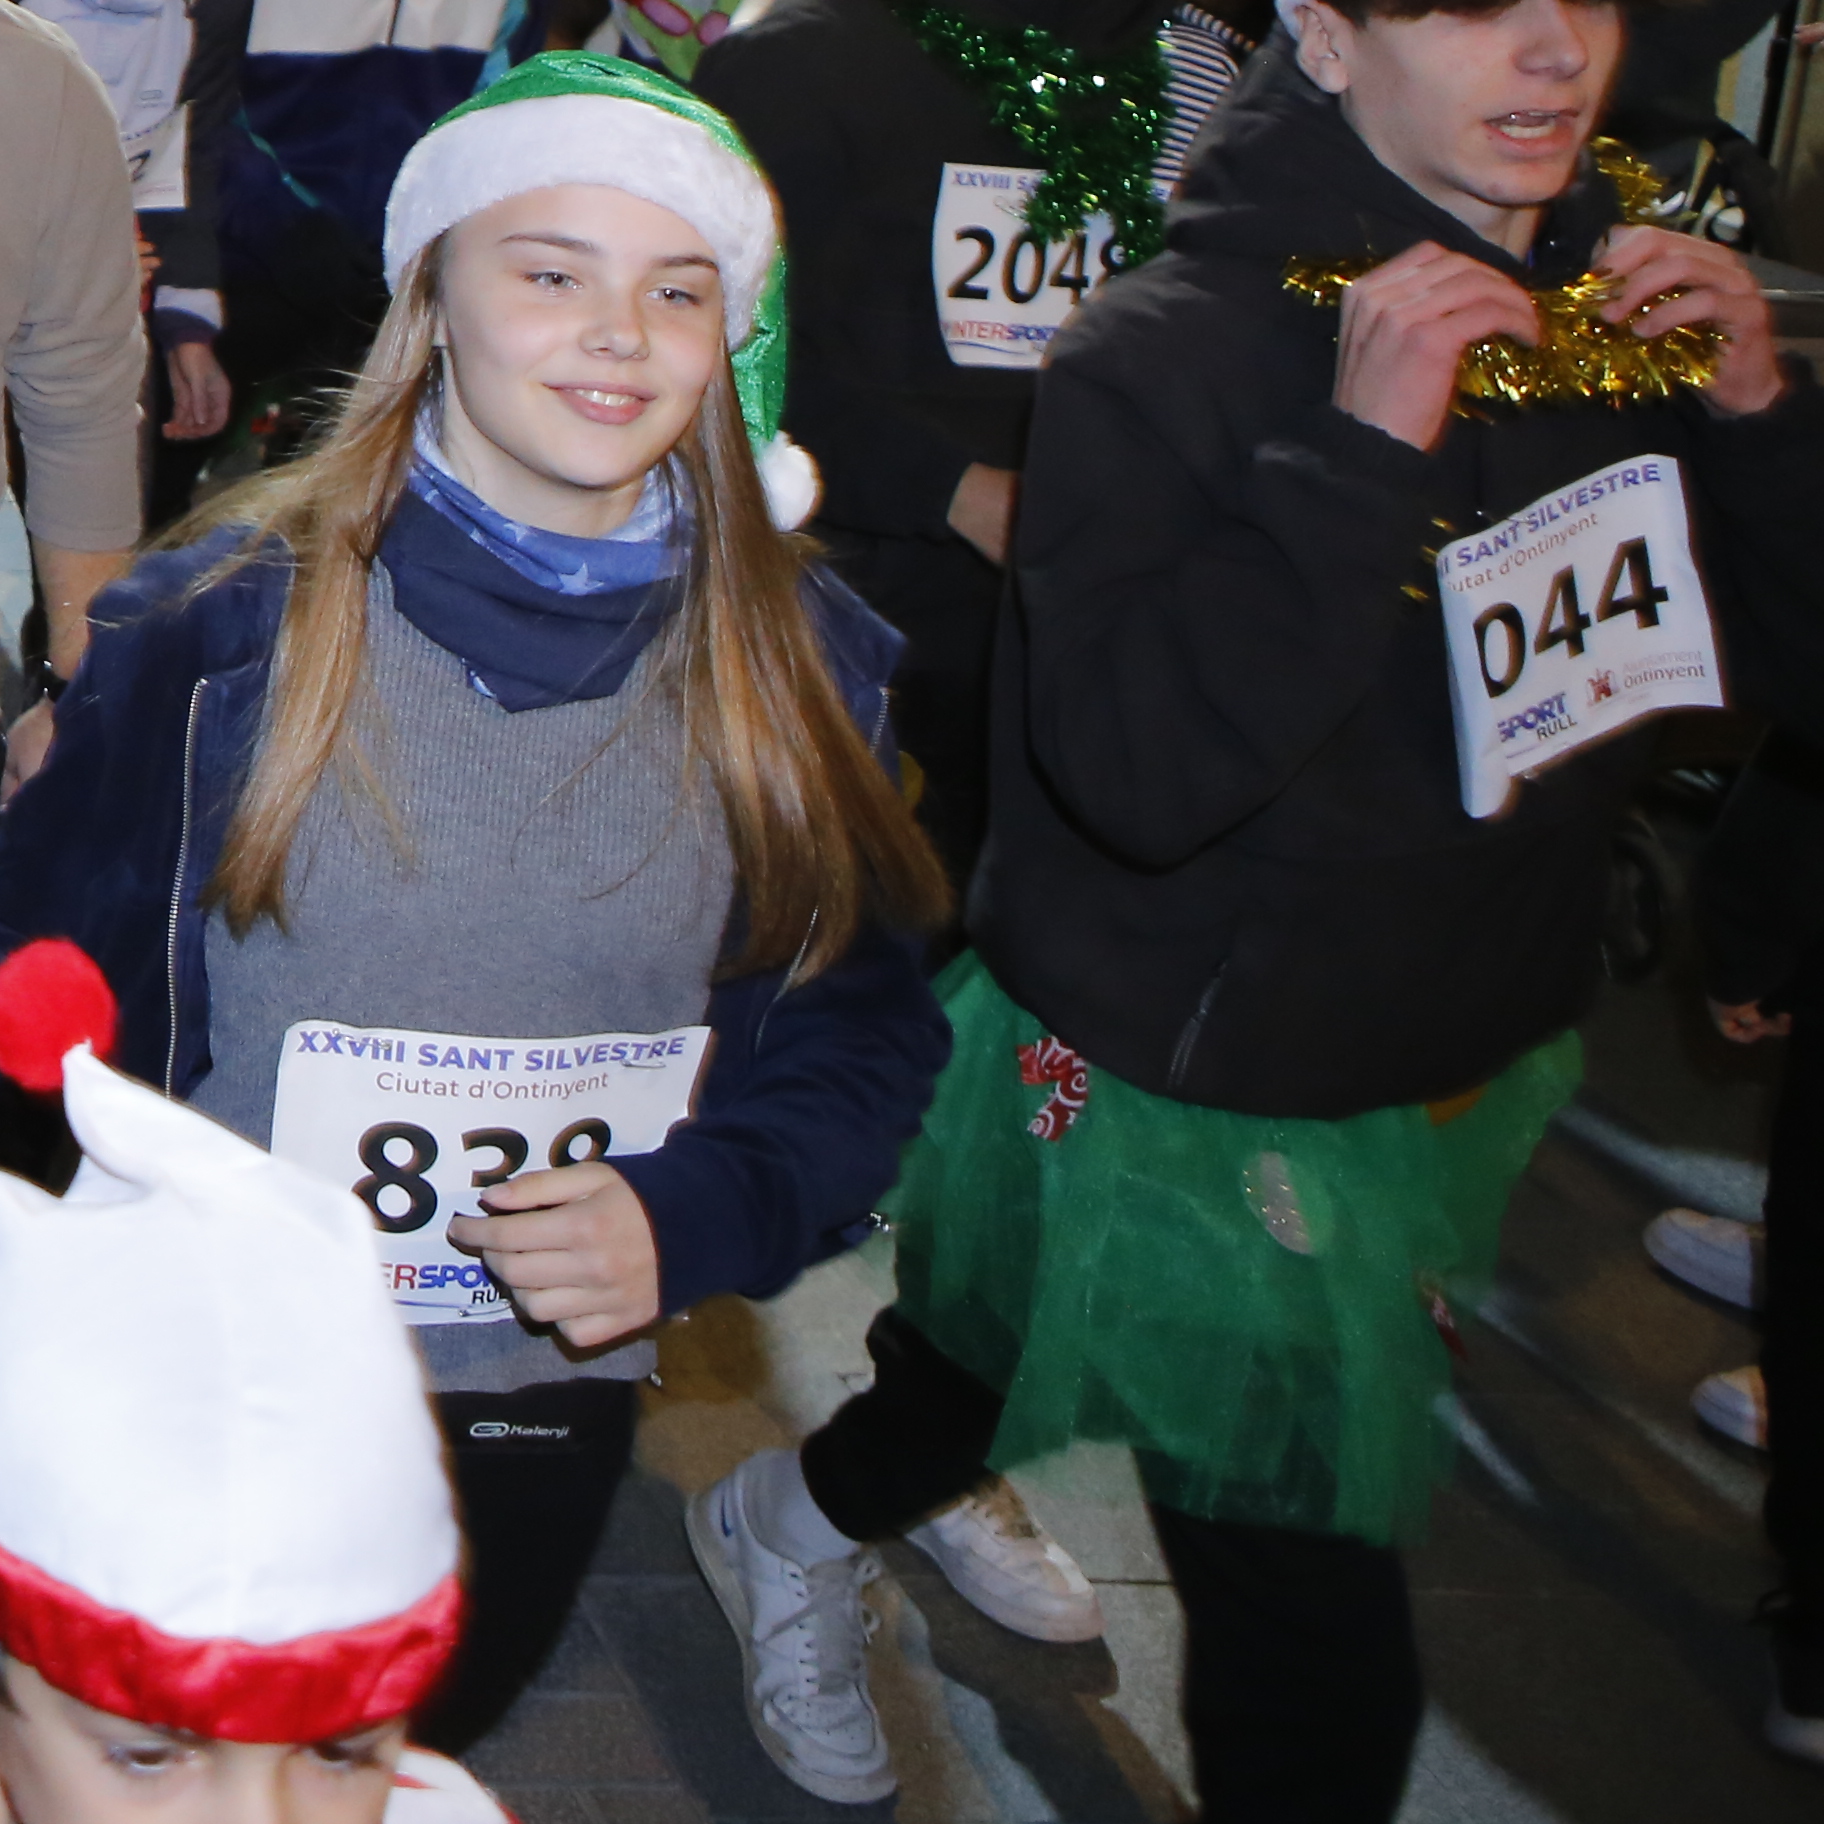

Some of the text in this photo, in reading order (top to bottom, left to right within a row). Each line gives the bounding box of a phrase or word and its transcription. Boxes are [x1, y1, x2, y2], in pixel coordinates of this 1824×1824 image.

[952, 172, 1010, 190] XXVIII
[1455, 462, 1662, 569] SANT SILVESTRE
[1499, 511, 1599, 578] d'Ontinyent
[1472, 534, 1671, 700] 044
[1623, 663, 1706, 690] Ontinyent
[1535, 713, 1579, 742] RULL
[295, 1029, 687, 1072] XXVIII SANT SILVESTRE
[375, 1071, 609, 1101] Ciutat d'Ontinyent
[510, 1423, 571, 1440] Kalenji
